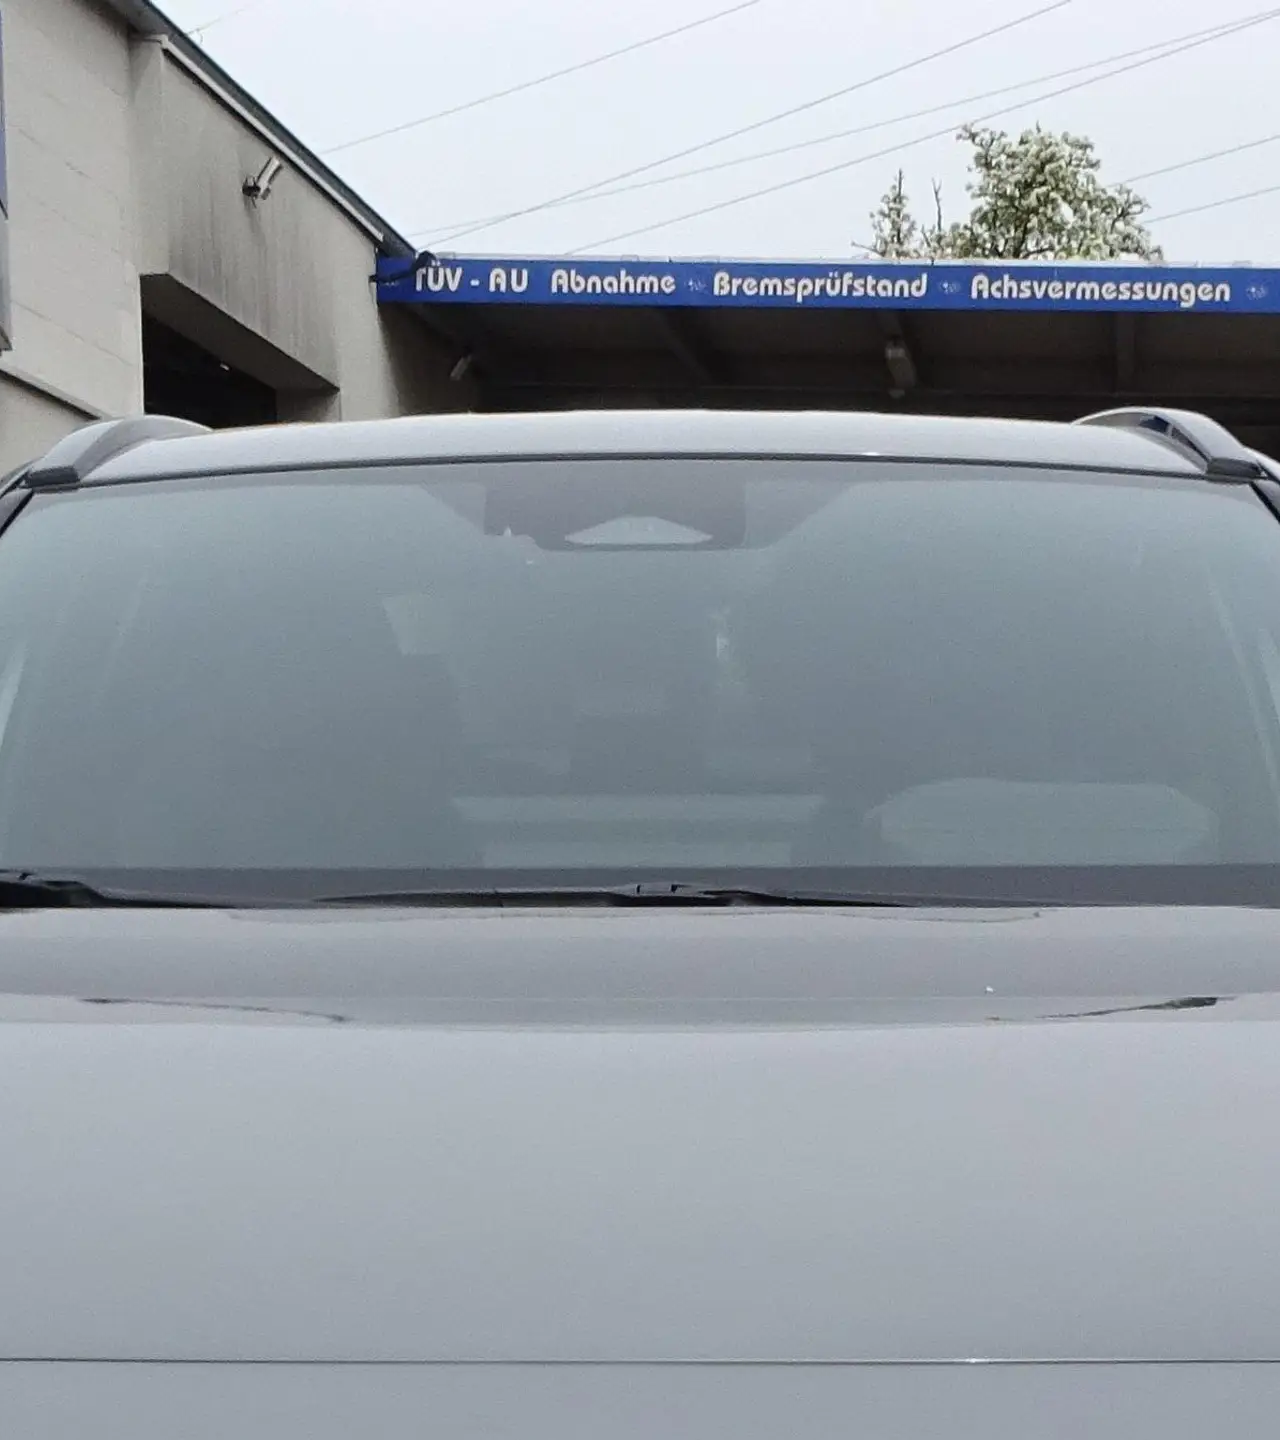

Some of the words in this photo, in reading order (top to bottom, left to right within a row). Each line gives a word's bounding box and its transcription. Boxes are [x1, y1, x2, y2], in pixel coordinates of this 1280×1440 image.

[414, 260, 463, 292] TÜV
[488, 268, 529, 293] AU
[549, 269, 677, 296] Abnahme
[712, 270, 929, 302] Bremsprüfstand
[969, 272, 1231, 307] Achsvermessungen
